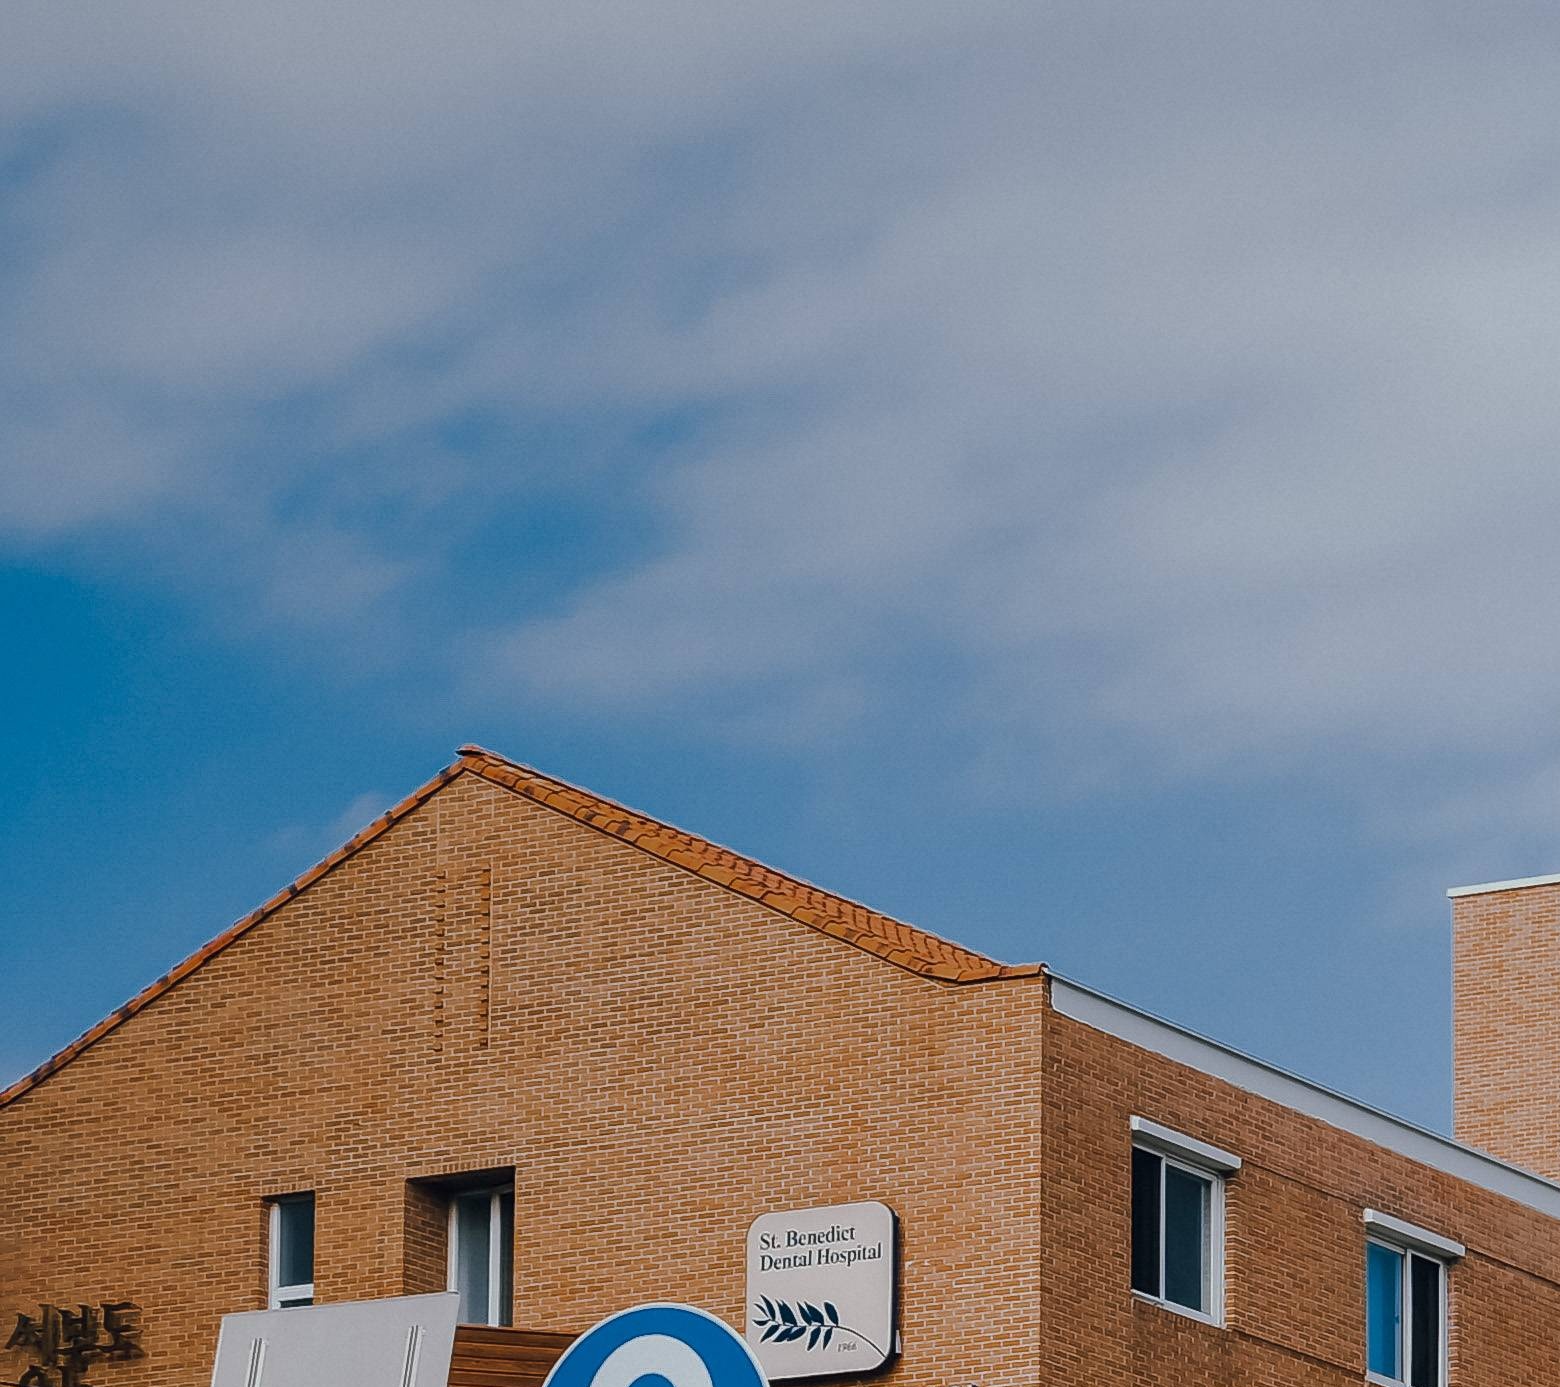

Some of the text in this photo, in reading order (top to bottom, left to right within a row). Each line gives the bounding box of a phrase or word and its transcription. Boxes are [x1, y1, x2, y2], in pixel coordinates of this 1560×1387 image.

[760, 1225, 856, 1250] St. Benedict
[760, 1242, 882, 1272] Dental Hospital
